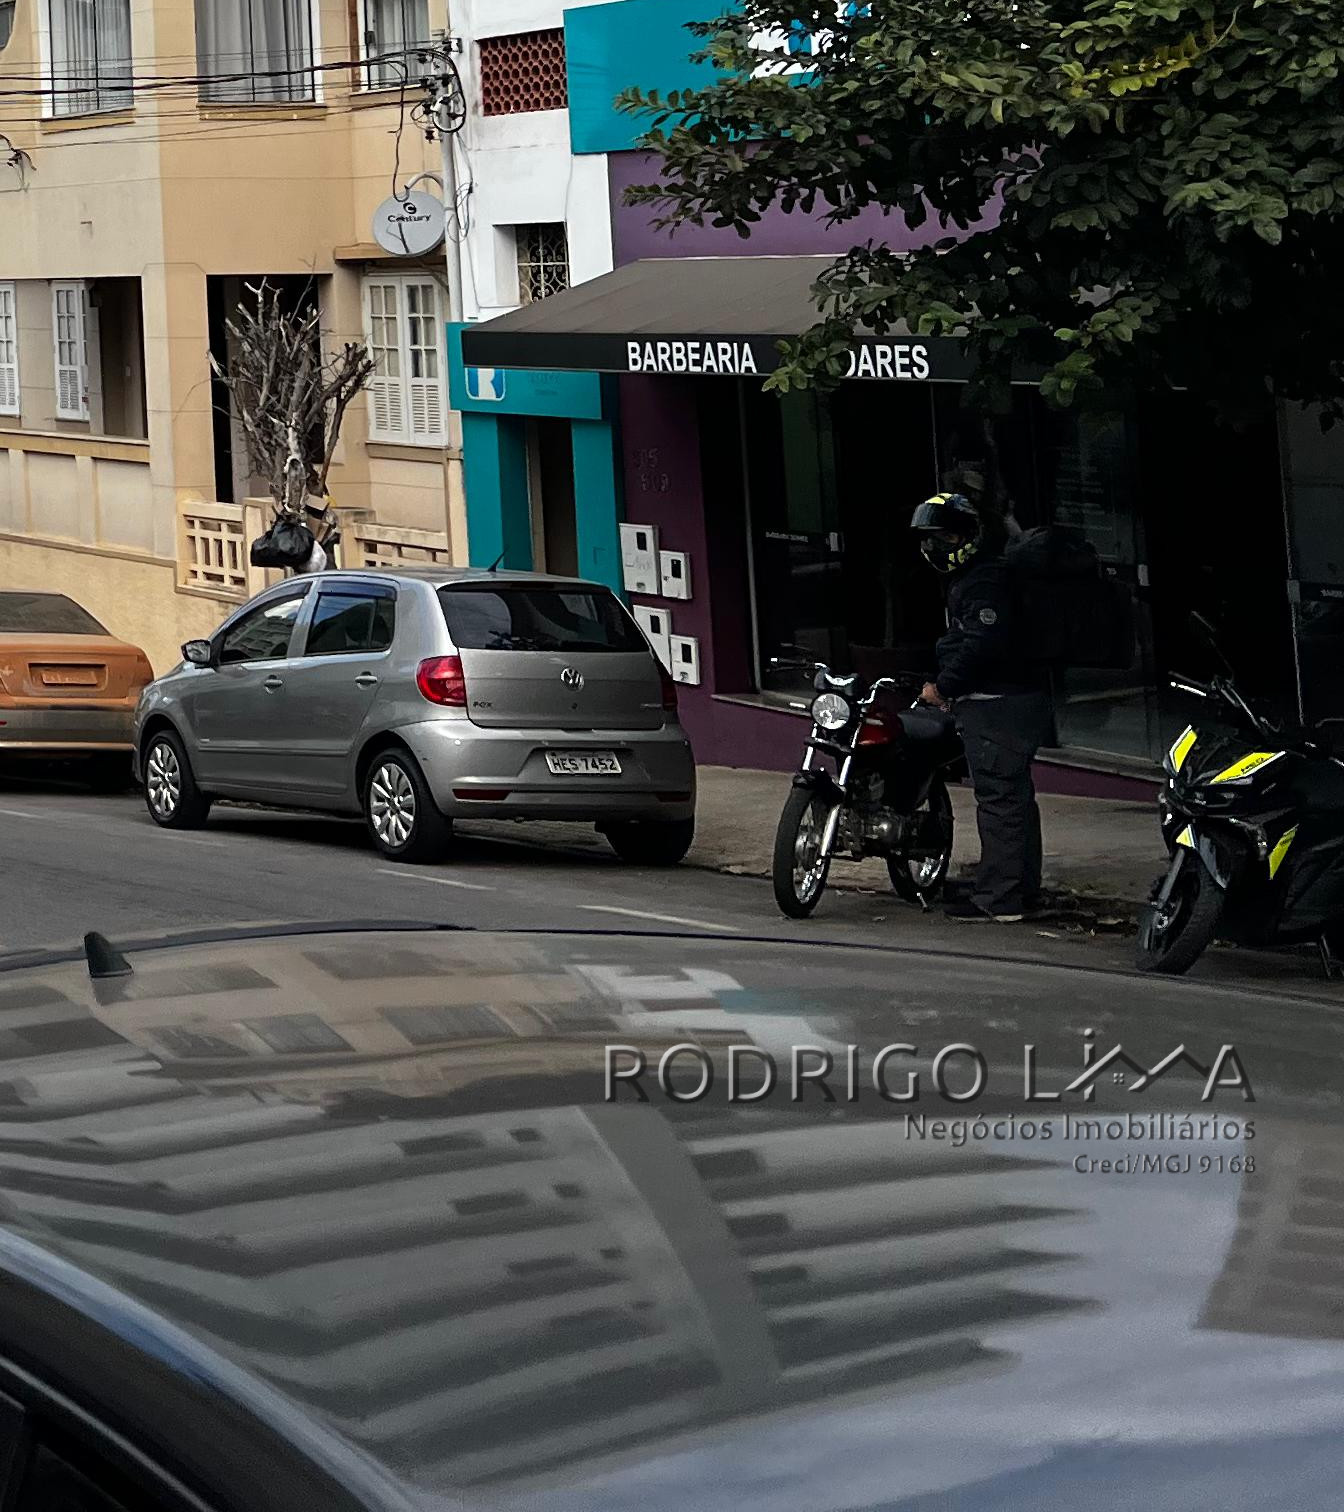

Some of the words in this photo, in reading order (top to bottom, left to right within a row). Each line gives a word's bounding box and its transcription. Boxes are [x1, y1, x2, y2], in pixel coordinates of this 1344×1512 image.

[626, 341, 758, 374] BARBEARIA
[843, 344, 930, 379] ARES
[552, 757, 579, 771] HES
[582, 757, 617, 771] 7452
